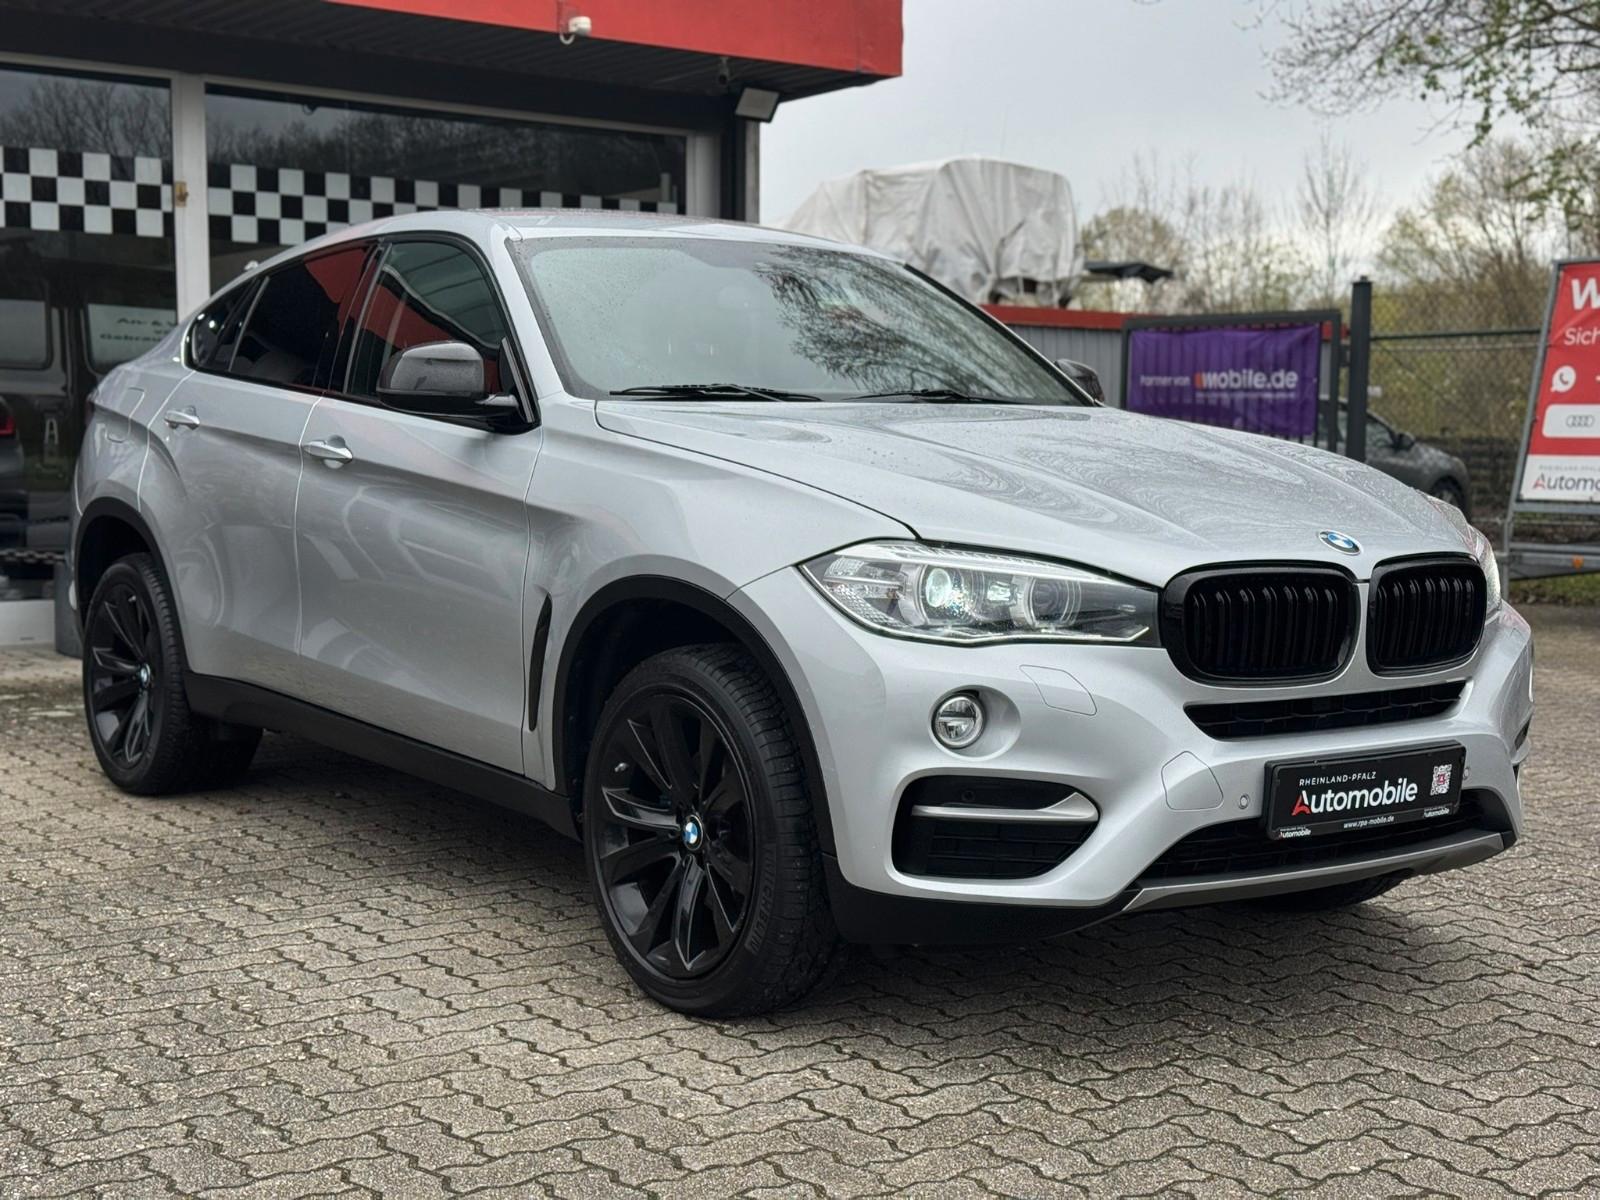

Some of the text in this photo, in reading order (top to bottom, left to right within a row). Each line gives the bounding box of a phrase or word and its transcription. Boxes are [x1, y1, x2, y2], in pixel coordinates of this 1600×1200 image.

[1194, 369, 1299, 389] mobile.de
[1299, 771, 1377, 787] RHEINLAND-PFALZ
[1291, 777, 1418, 816] Automobile
